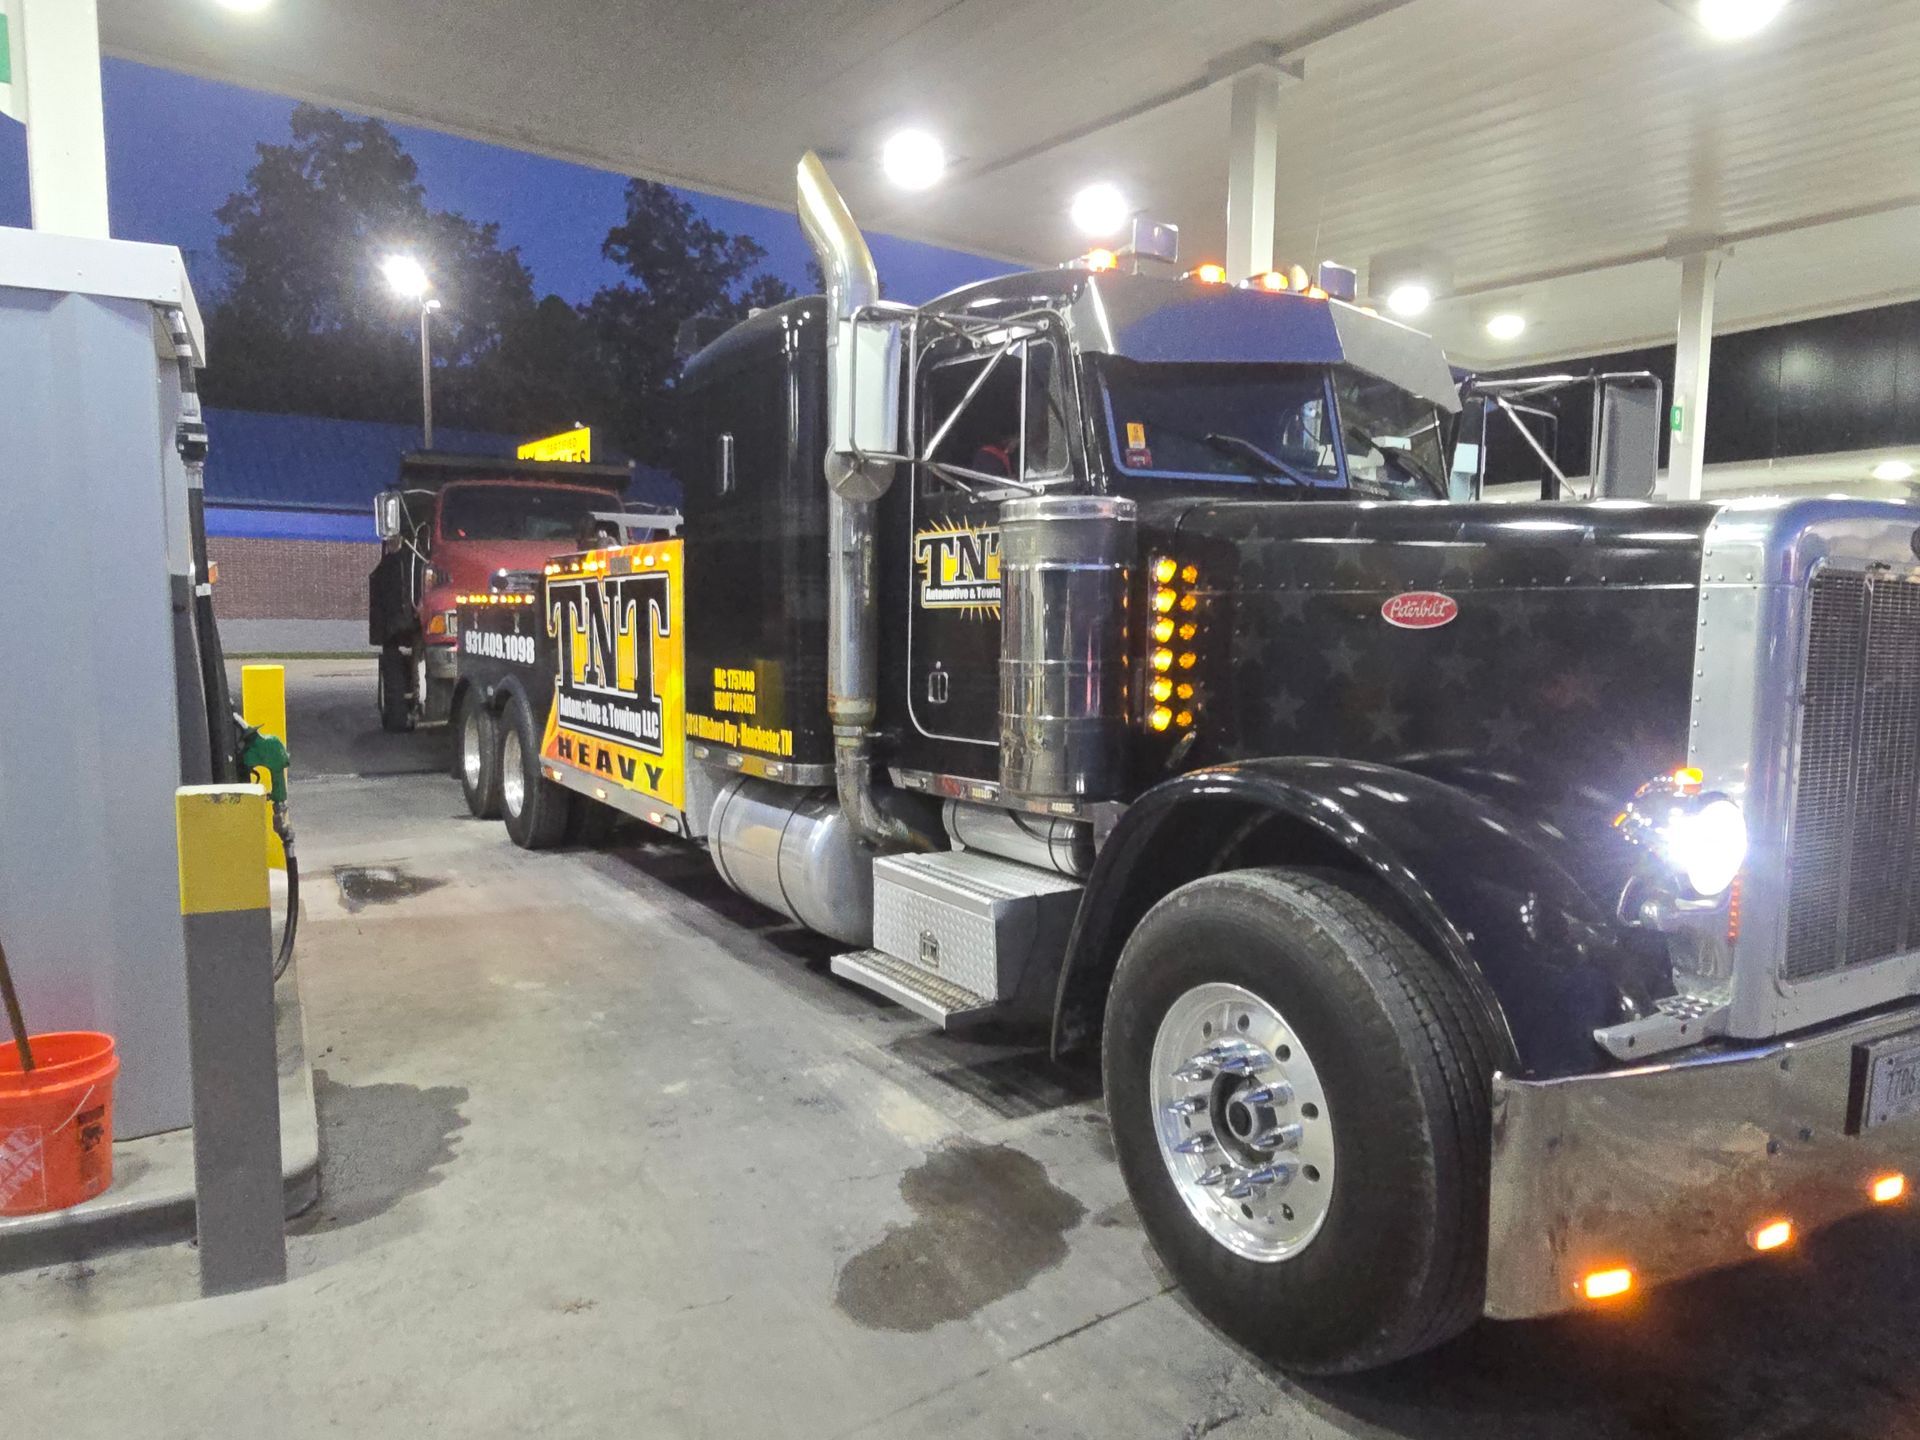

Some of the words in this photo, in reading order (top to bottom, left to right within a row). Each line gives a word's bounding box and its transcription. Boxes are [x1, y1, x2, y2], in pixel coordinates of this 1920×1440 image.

[925, 587, 969, 600] Automotive
[970, 589, 976, 599] &
[1390, 599, 1451, 618] Peterbilt
[465, 630, 535, 664] 931.409.1098
[547, 573, 670, 699] TNT
[560, 693, 601, 725] Automotive
[602, 705, 609, 727] &
[608, 702, 641, 738] Towing
[642, 709, 659, 739] LLC
[781, 729, 793, 757] TN
[558, 735, 664, 791] HEAVY
